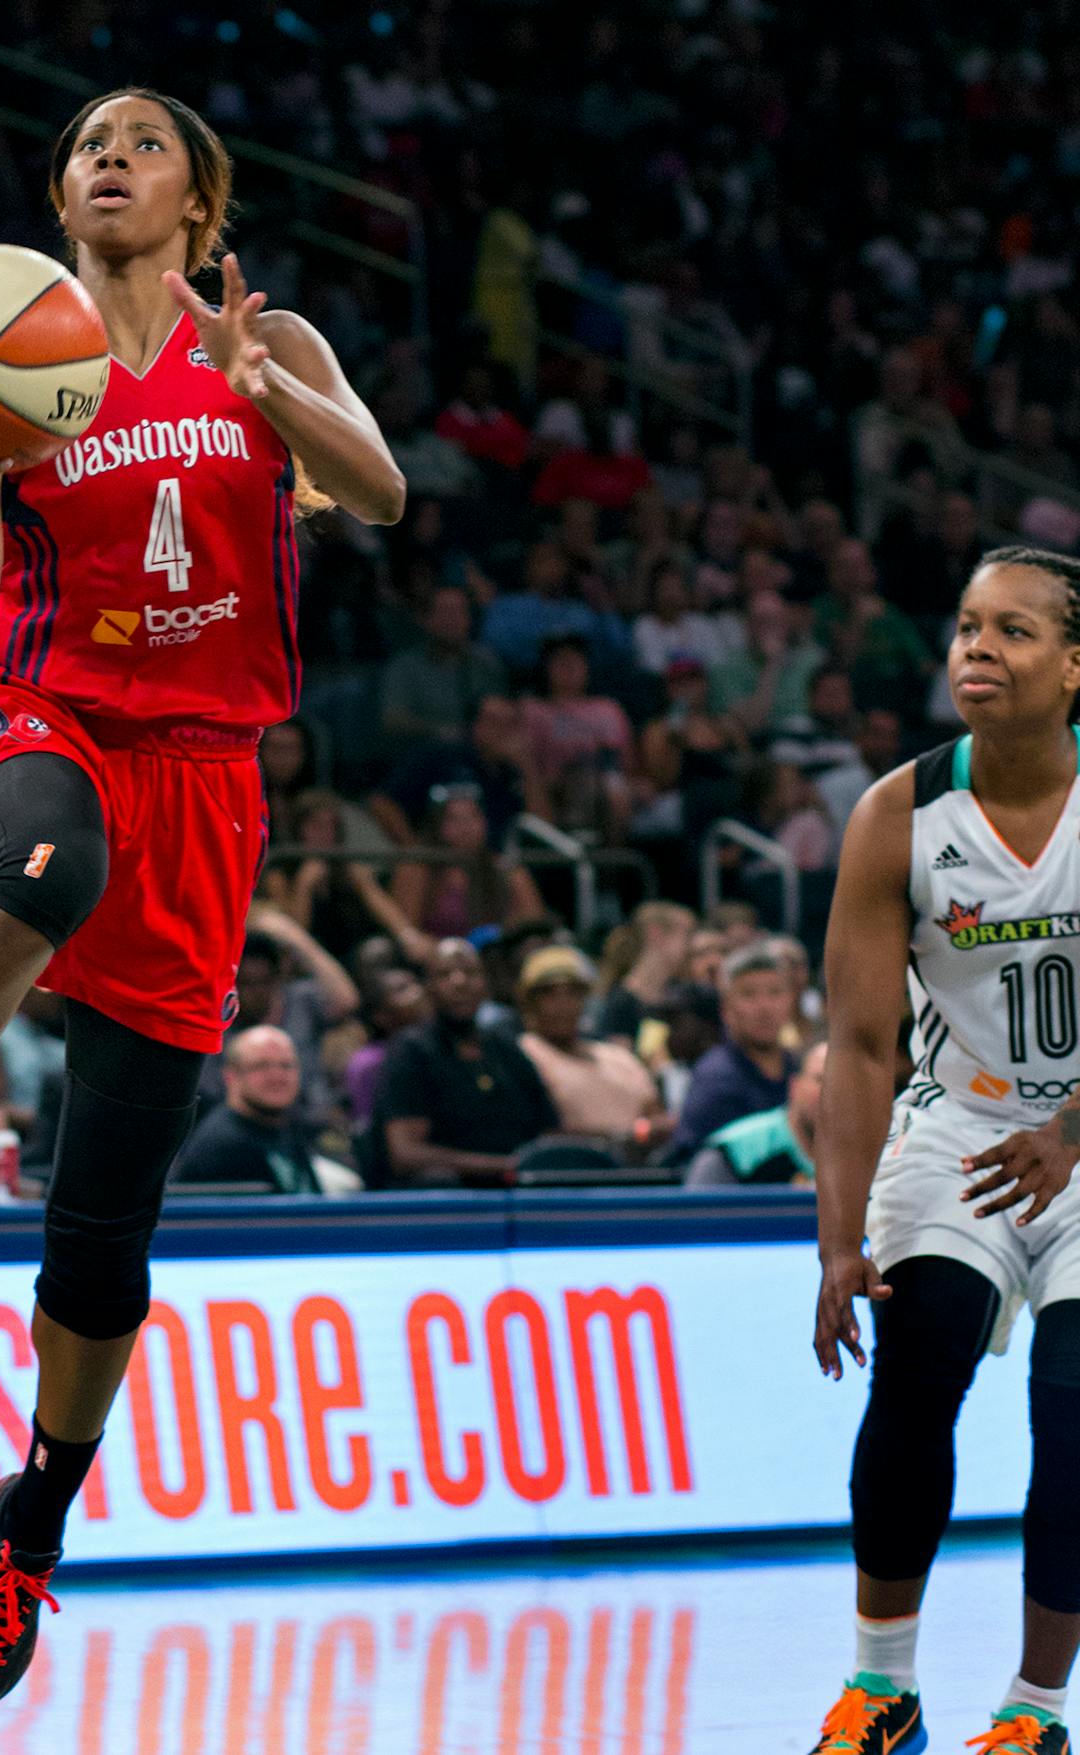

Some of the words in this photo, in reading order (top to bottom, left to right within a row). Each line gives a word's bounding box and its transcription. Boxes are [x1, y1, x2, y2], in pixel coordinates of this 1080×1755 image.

[47, 387, 104, 420] SPAL
[55, 413, 251, 487] Washington
[143, 478, 193, 592] 4
[144, 592, 240, 632] boost
[1000, 954, 1077, 1063] 10
